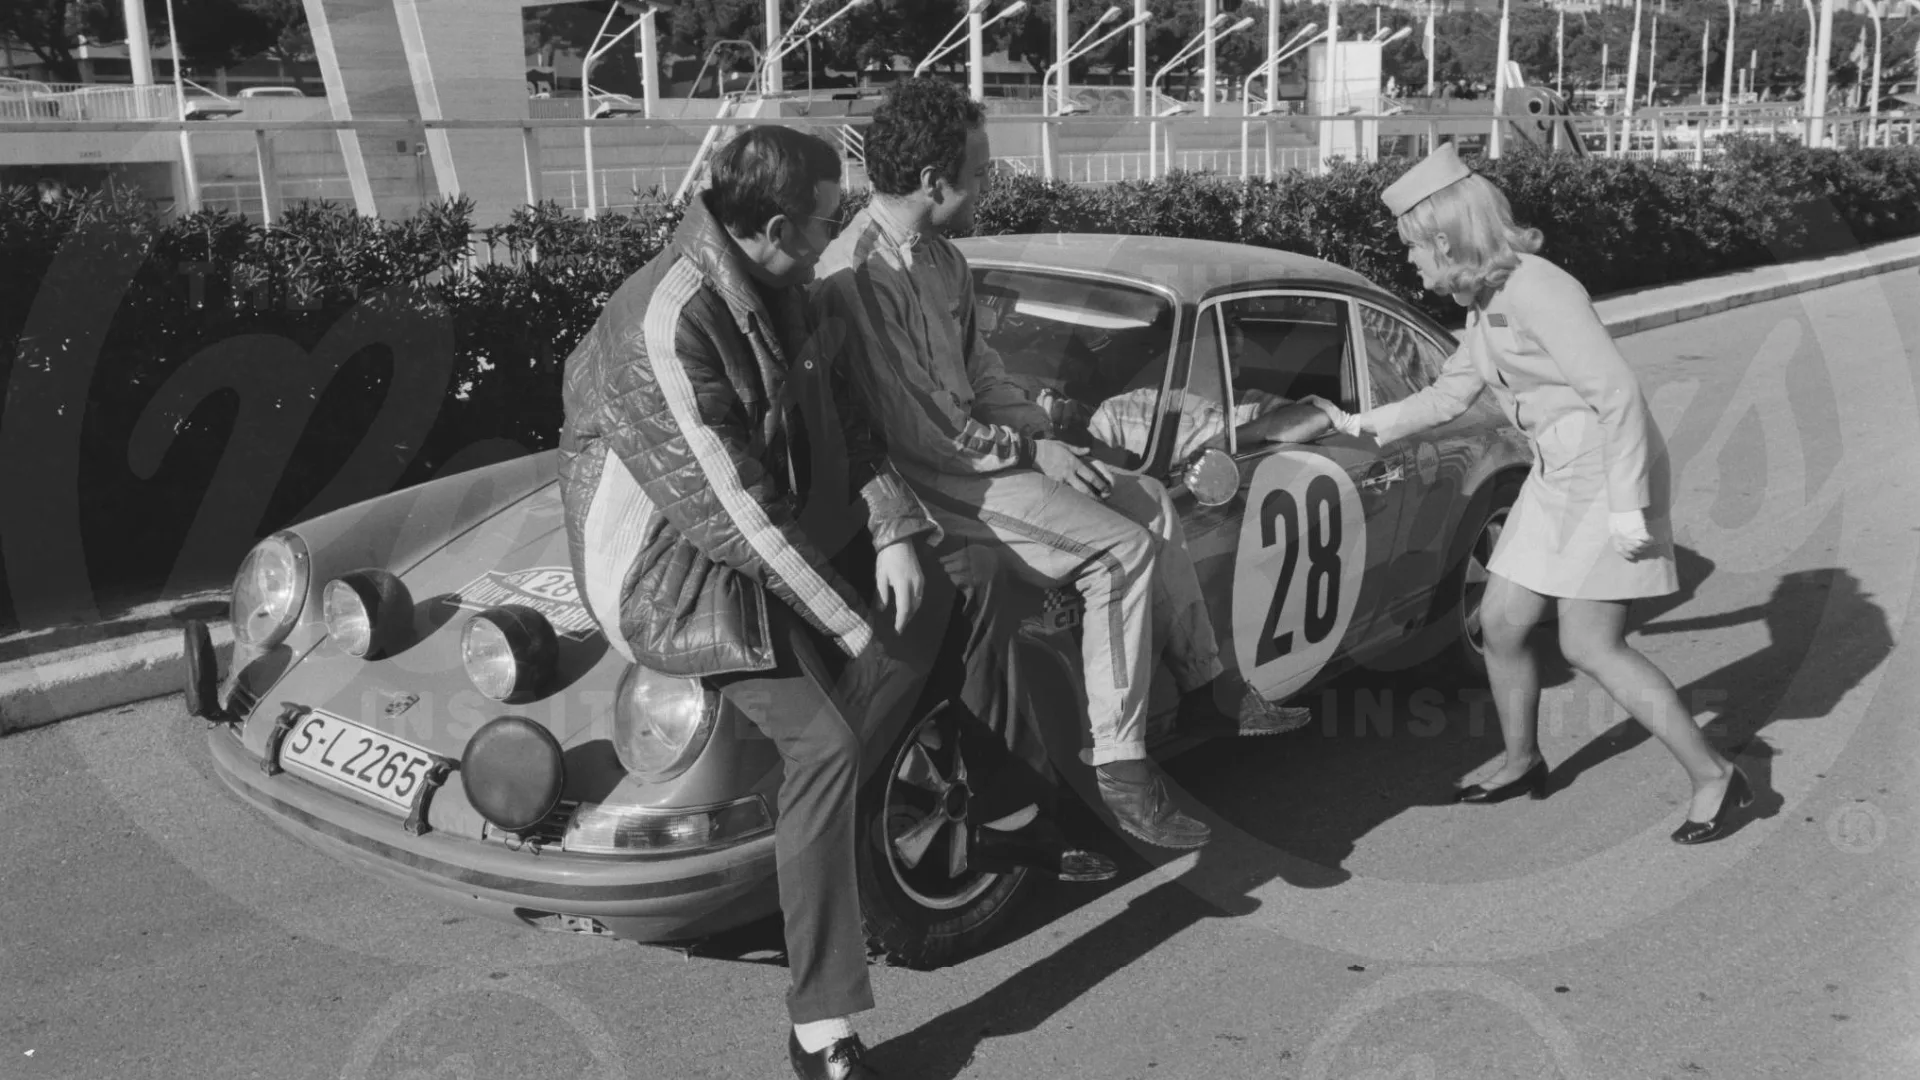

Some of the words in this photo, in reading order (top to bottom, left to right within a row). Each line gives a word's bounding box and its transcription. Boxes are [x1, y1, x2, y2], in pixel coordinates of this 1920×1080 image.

[532, 574, 577, 597] 28
[1255, 474, 1342, 668] 28
[340, 738, 428, 797] 2265
